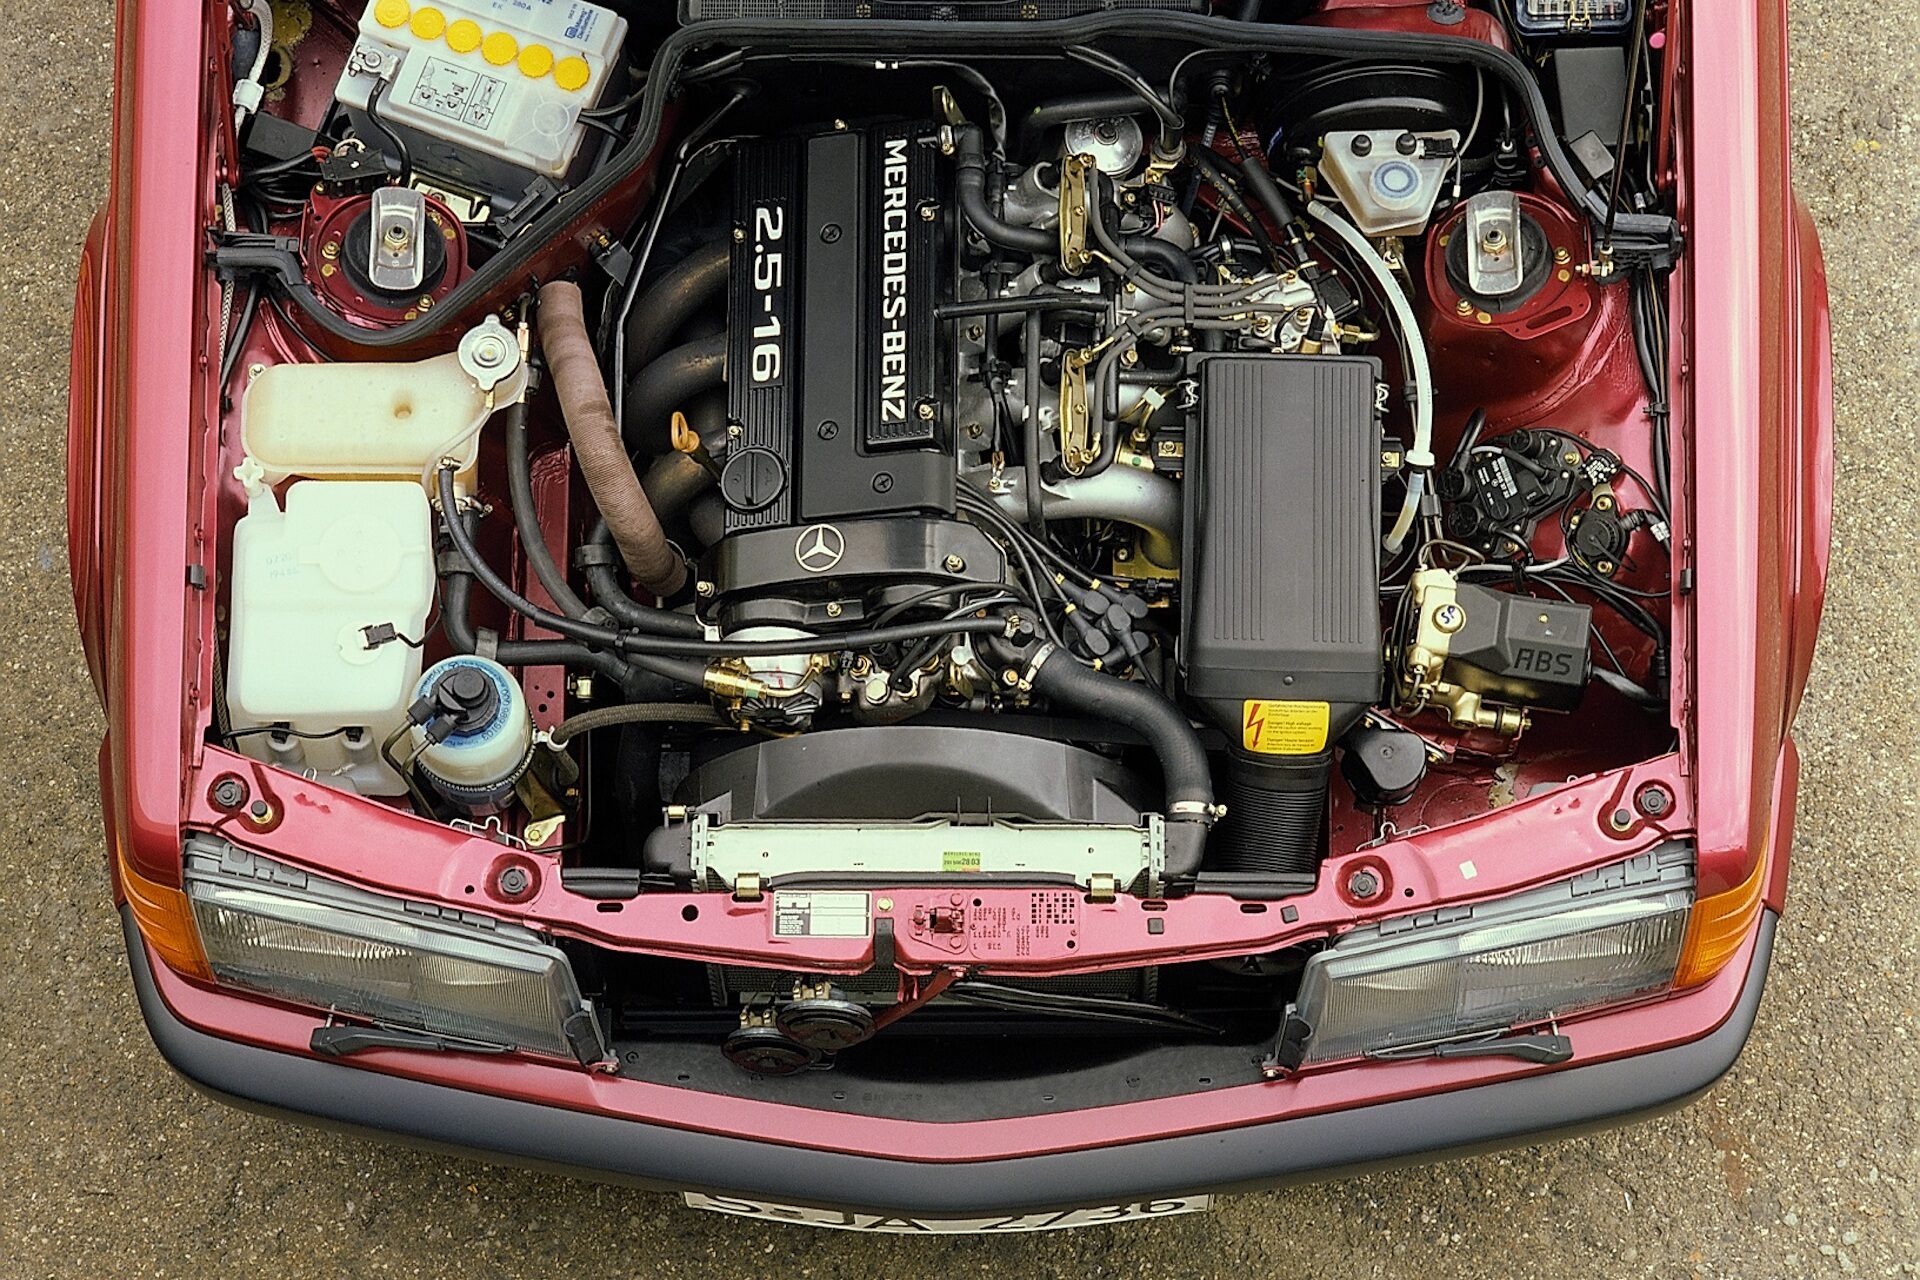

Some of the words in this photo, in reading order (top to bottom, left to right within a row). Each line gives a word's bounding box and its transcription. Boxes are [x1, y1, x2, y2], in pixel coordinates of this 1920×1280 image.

[752, 206, 784, 382] 2.5-16
[881, 138, 907, 422] MERCEDES-BENZ
[1513, 648, 1572, 676] ABS
